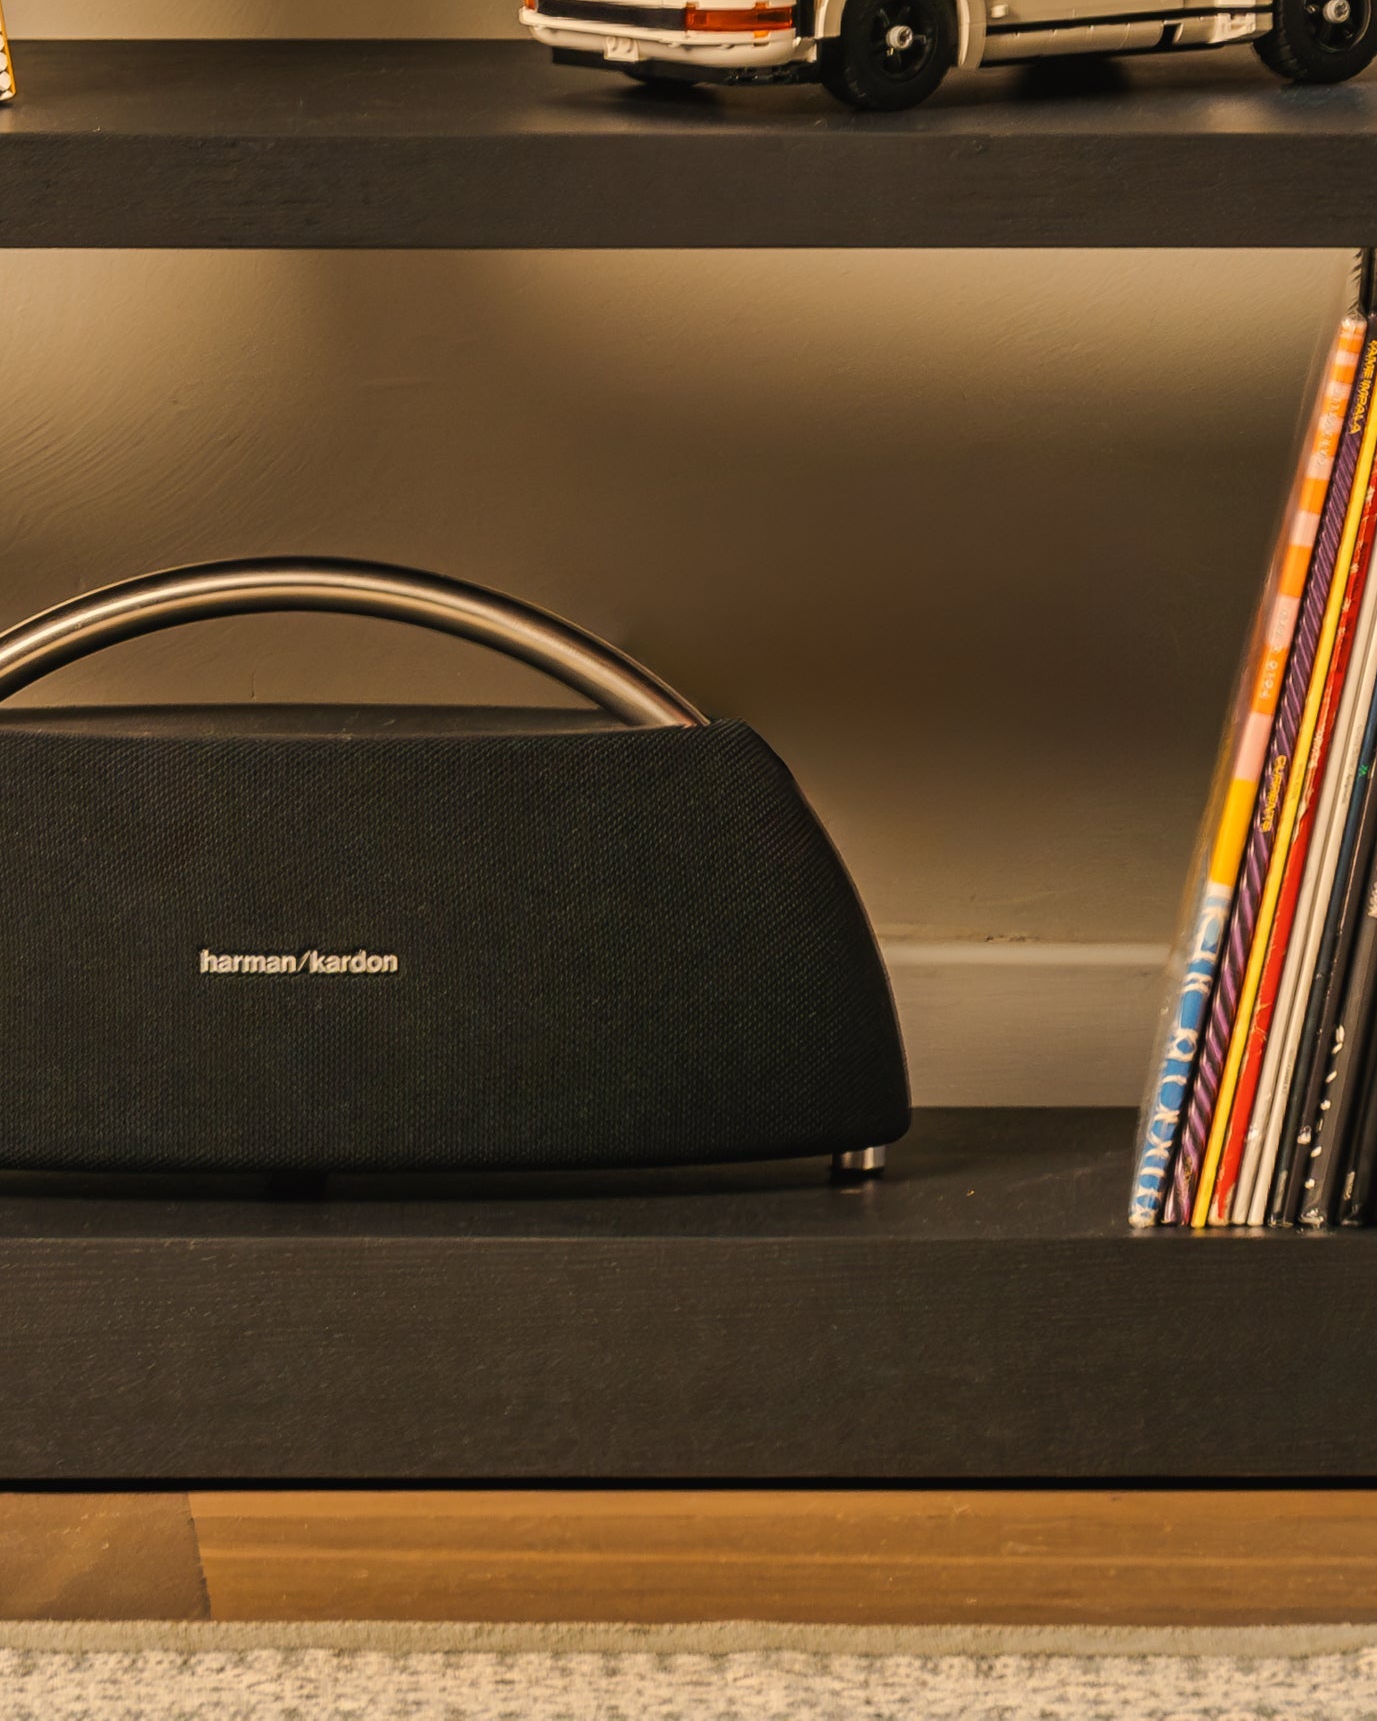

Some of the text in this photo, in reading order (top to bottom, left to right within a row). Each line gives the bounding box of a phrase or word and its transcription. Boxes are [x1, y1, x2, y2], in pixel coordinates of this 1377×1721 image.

[1349, 378, 1372, 435] IMPALA
[1258, 754, 1287, 833] CURRENTS
[199, 948, 399, 975] harman/kardon
